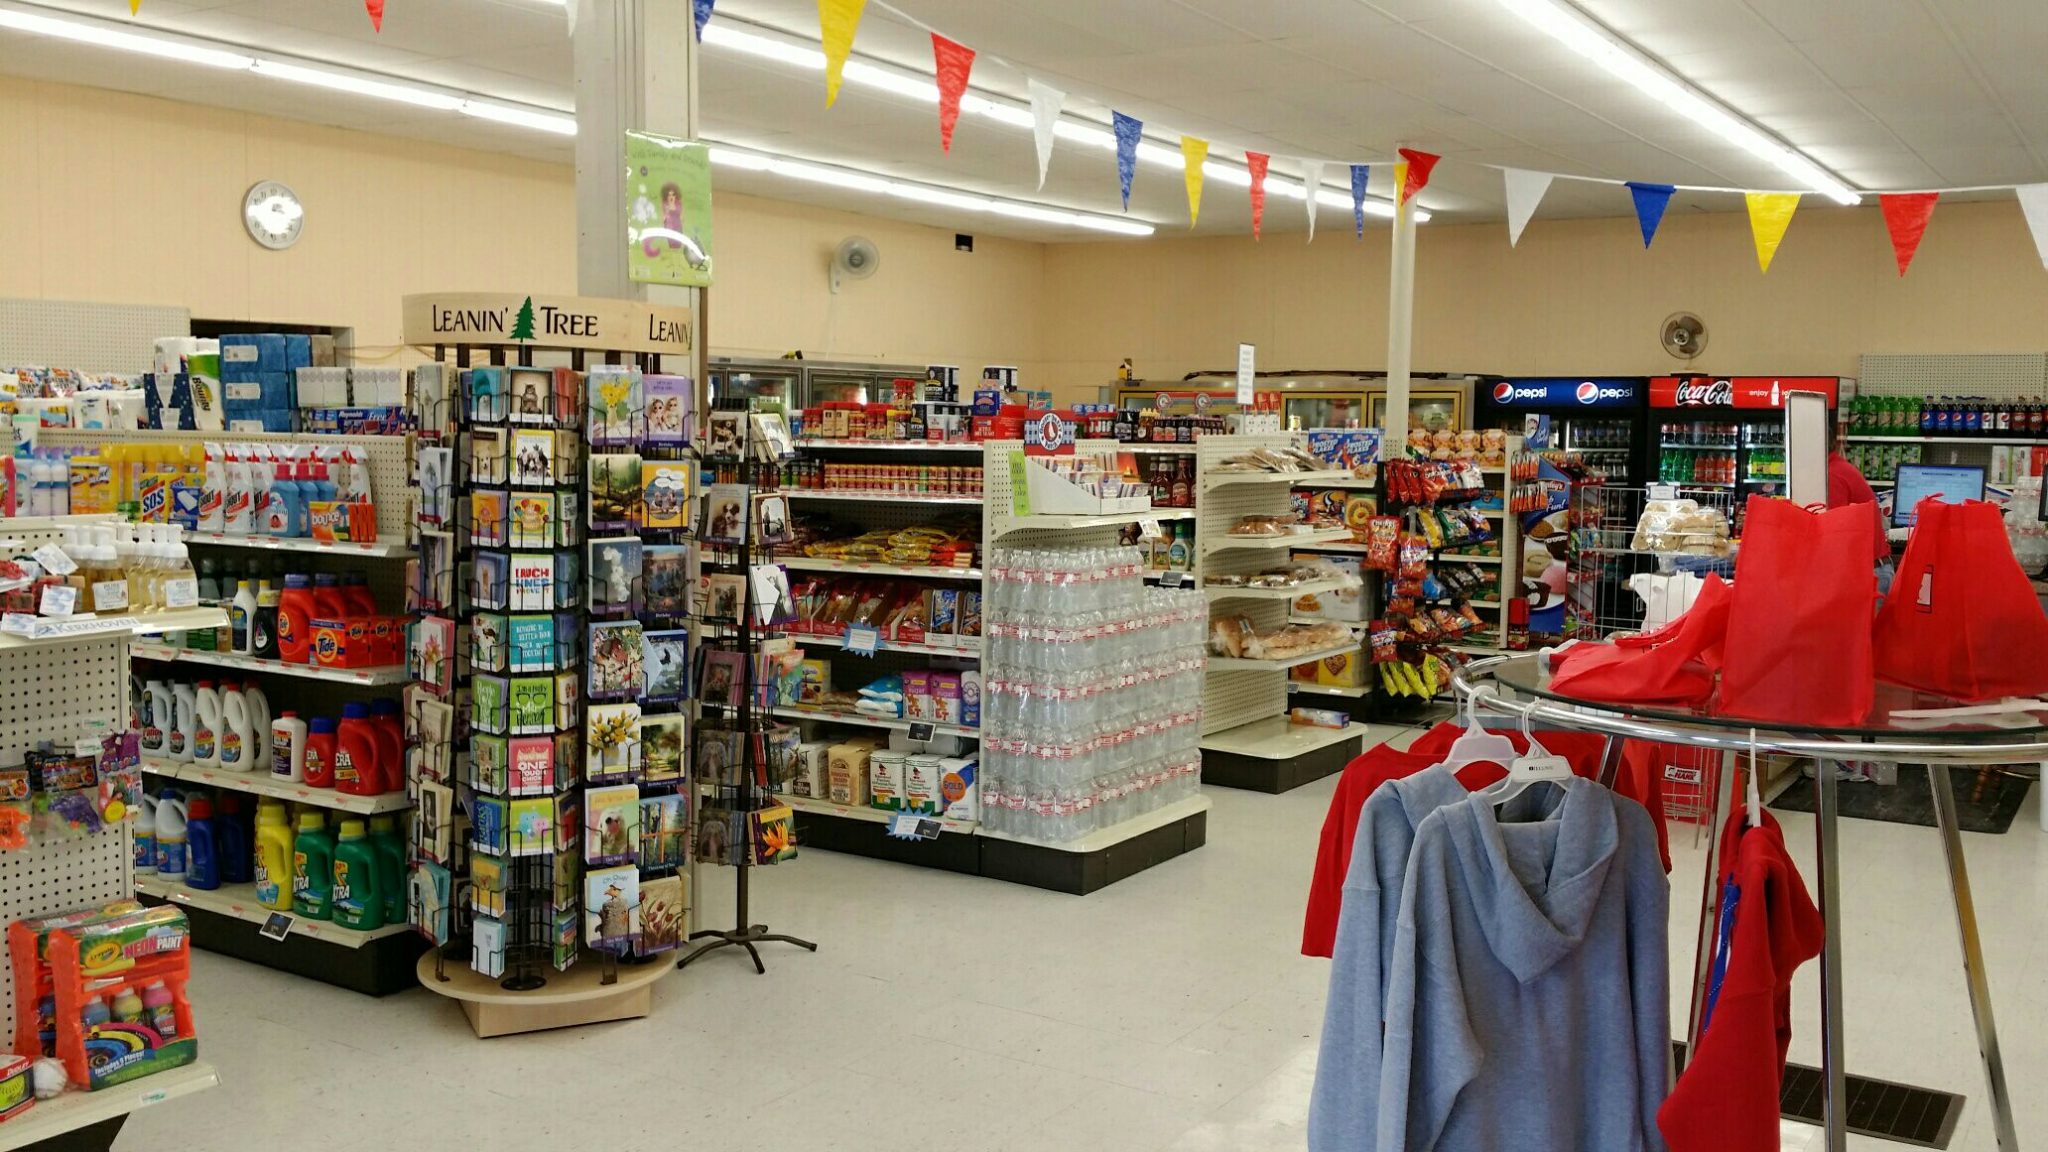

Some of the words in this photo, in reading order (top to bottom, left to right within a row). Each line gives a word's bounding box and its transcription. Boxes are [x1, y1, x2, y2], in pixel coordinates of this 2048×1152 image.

[432, 303, 508, 334] LEANIN'
[540, 306, 599, 337] TREE
[191, 377, 211, 412] Bounty
[1514, 387, 1548, 400] pepsi
[1599, 387, 1633, 400] pepsi
[1749, 389, 1768, 398] enjoy
[338, 410, 363, 419] Reynolds
[143, 488, 165, 513] SOS
[1546, 498, 1566, 513] Fun!
[311, 510, 341, 525] bounce
[317, 637, 336, 655] Tide
[335, 752, 351, 767] ERA
[518, 761, 548, 771] ONE
[122, 936, 157, 958] NEON
[157, 936, 182, 949] PAINT
